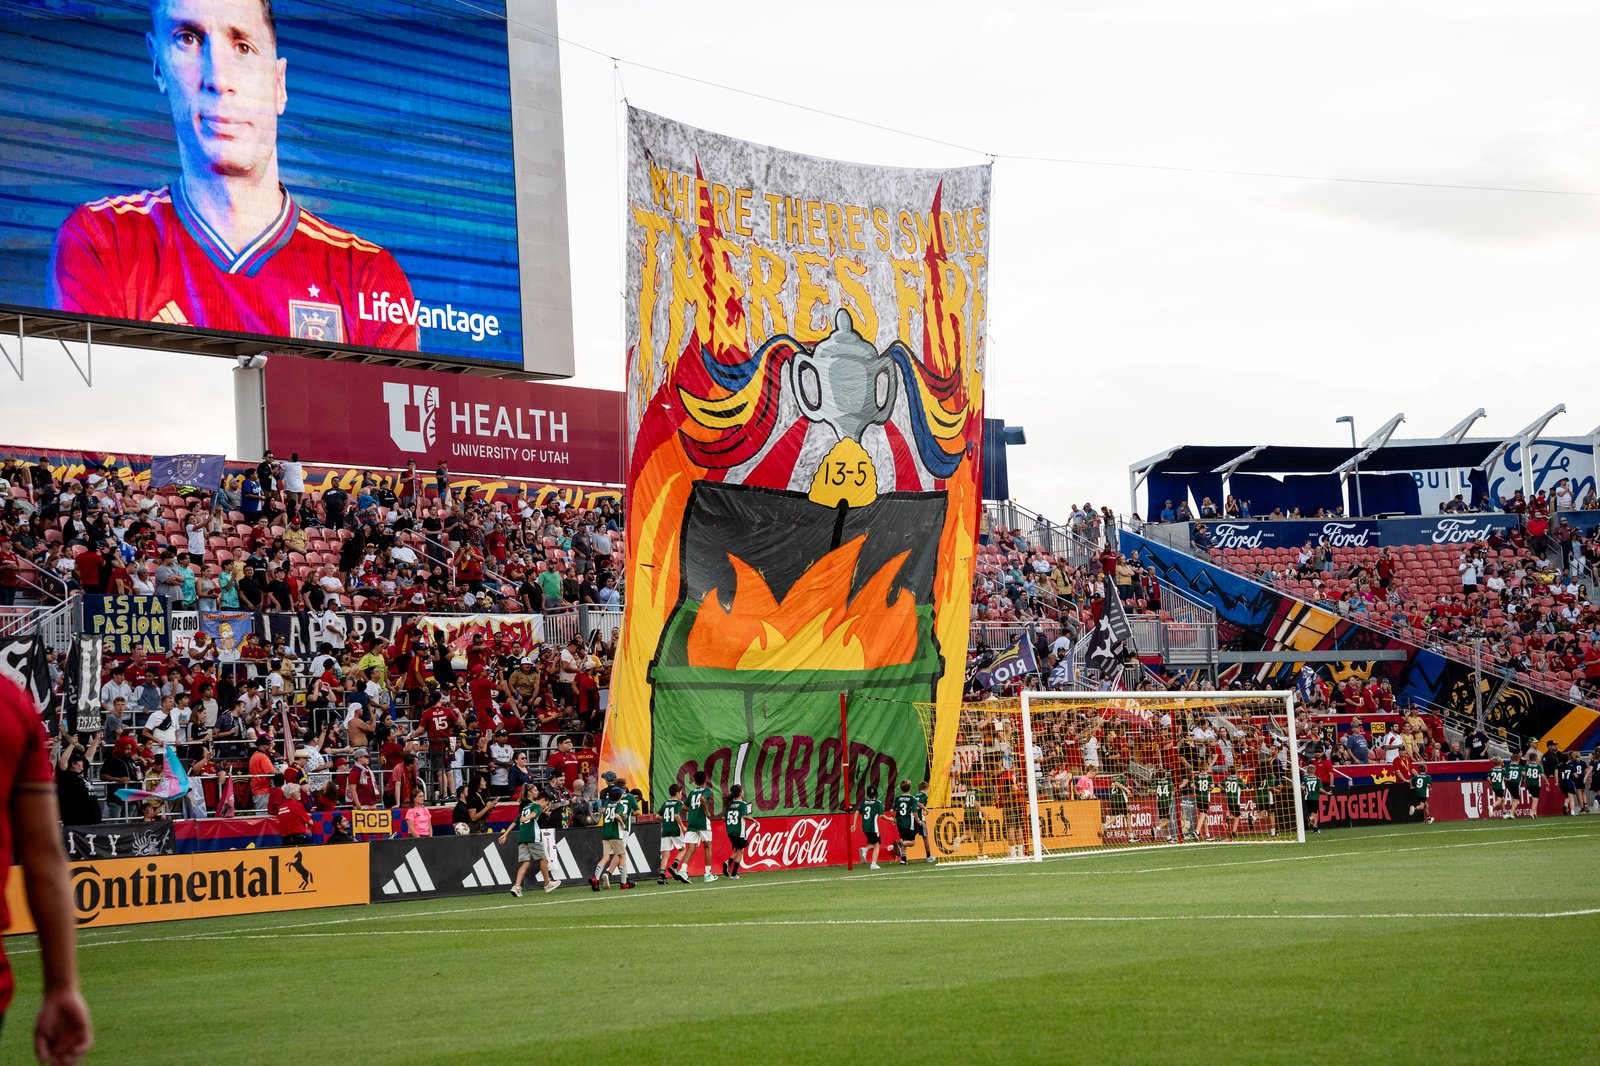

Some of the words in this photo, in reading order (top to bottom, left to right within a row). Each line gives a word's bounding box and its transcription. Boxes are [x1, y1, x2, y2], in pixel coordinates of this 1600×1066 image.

[650, 157, 753, 237] WHERE
[764, 194, 890, 252] THERE'S
[898, 206, 985, 255] SMOKE
[358, 291, 499, 341] LifeVantage
[451, 401, 569, 443] HEALTH
[452, 443, 519, 461] UNIVERSITY
[521, 448, 536, 462] OF
[539, 450, 569, 464] UTAH
[825, 461, 867, 486] 13-5
[1412, 470, 1472, 489] BUIL
[1211, 523, 1262, 548] Ford
[1318, 522, 1369, 548] Ford
[1432, 518, 1492, 543] Ford
[104, 595, 164, 615] ESTA
[183, 616, 198, 631] ORO
[432, 716, 448, 731] 15
[581, 761, 590, 773] 8
[1509, 770, 1519, 780] 19
[1526, 768, 1538, 779] 48
[1416, 778, 1424, 788] 9
[1491, 772, 1502, 782] 24
[1306, 780, 1317, 792] 17
[690, 793, 702, 810] 44
[900, 802, 907, 816] 3
[1310, 788, 1391, 825] EATGEEK
[354, 813, 389, 828] RCB
[605, 806, 617, 823] 24
[663, 807, 675, 822] 41
[726, 810, 739, 825] 53
[864, 806, 871, 820] 3
[1130, 813, 1151, 827] CARD
[68, 831, 121, 856] ITY
[740, 818, 832, 869] Coca-Cola
[70, 855, 282, 925] Continental
